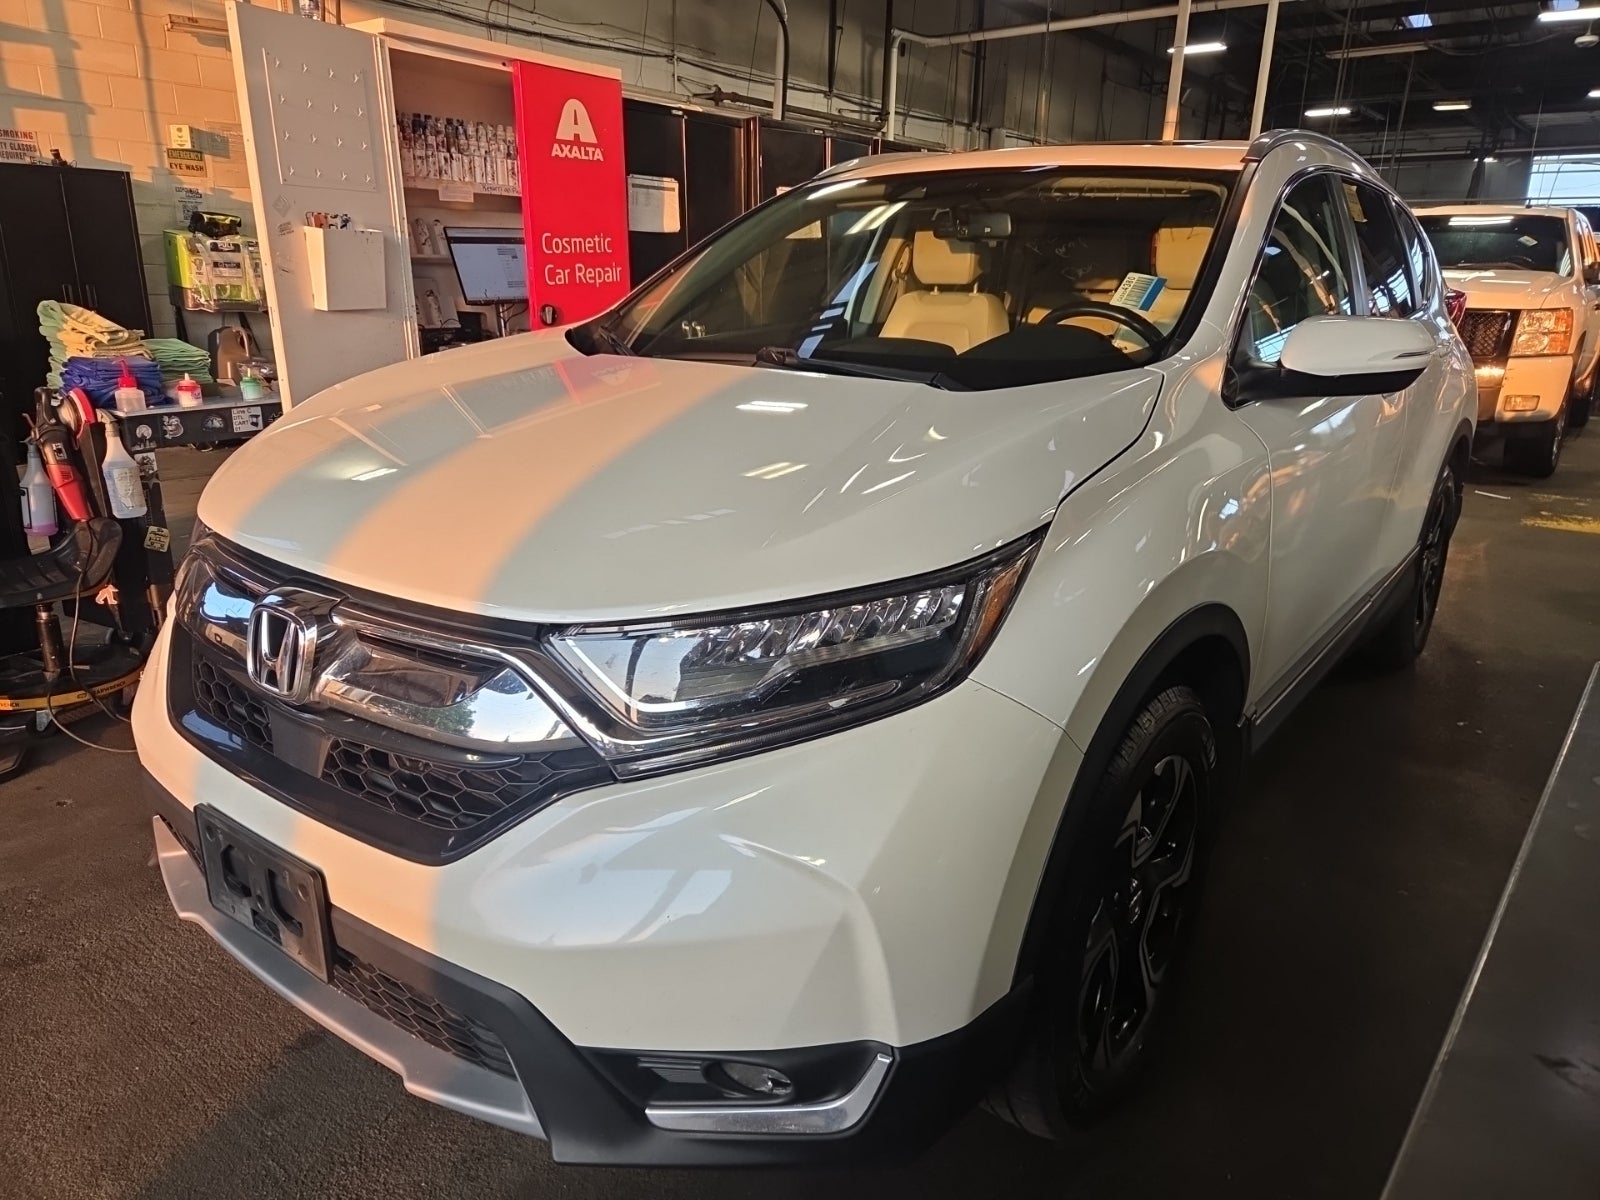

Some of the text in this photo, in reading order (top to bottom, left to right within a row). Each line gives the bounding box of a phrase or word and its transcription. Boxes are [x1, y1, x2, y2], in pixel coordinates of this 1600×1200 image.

[0, 129, 33, 140] SMOKING
[10, 142, 37, 152] GLASSES
[551, 143, 604, 162] AXALTA
[0, 150, 26, 160] EQUIRE
[168, 149, 202, 160] EMERGENCY
[169, 162, 204, 172] EYE WASH
[541, 232, 613, 254] Cosmetic
[544, 262, 622, 287] Car Repair
